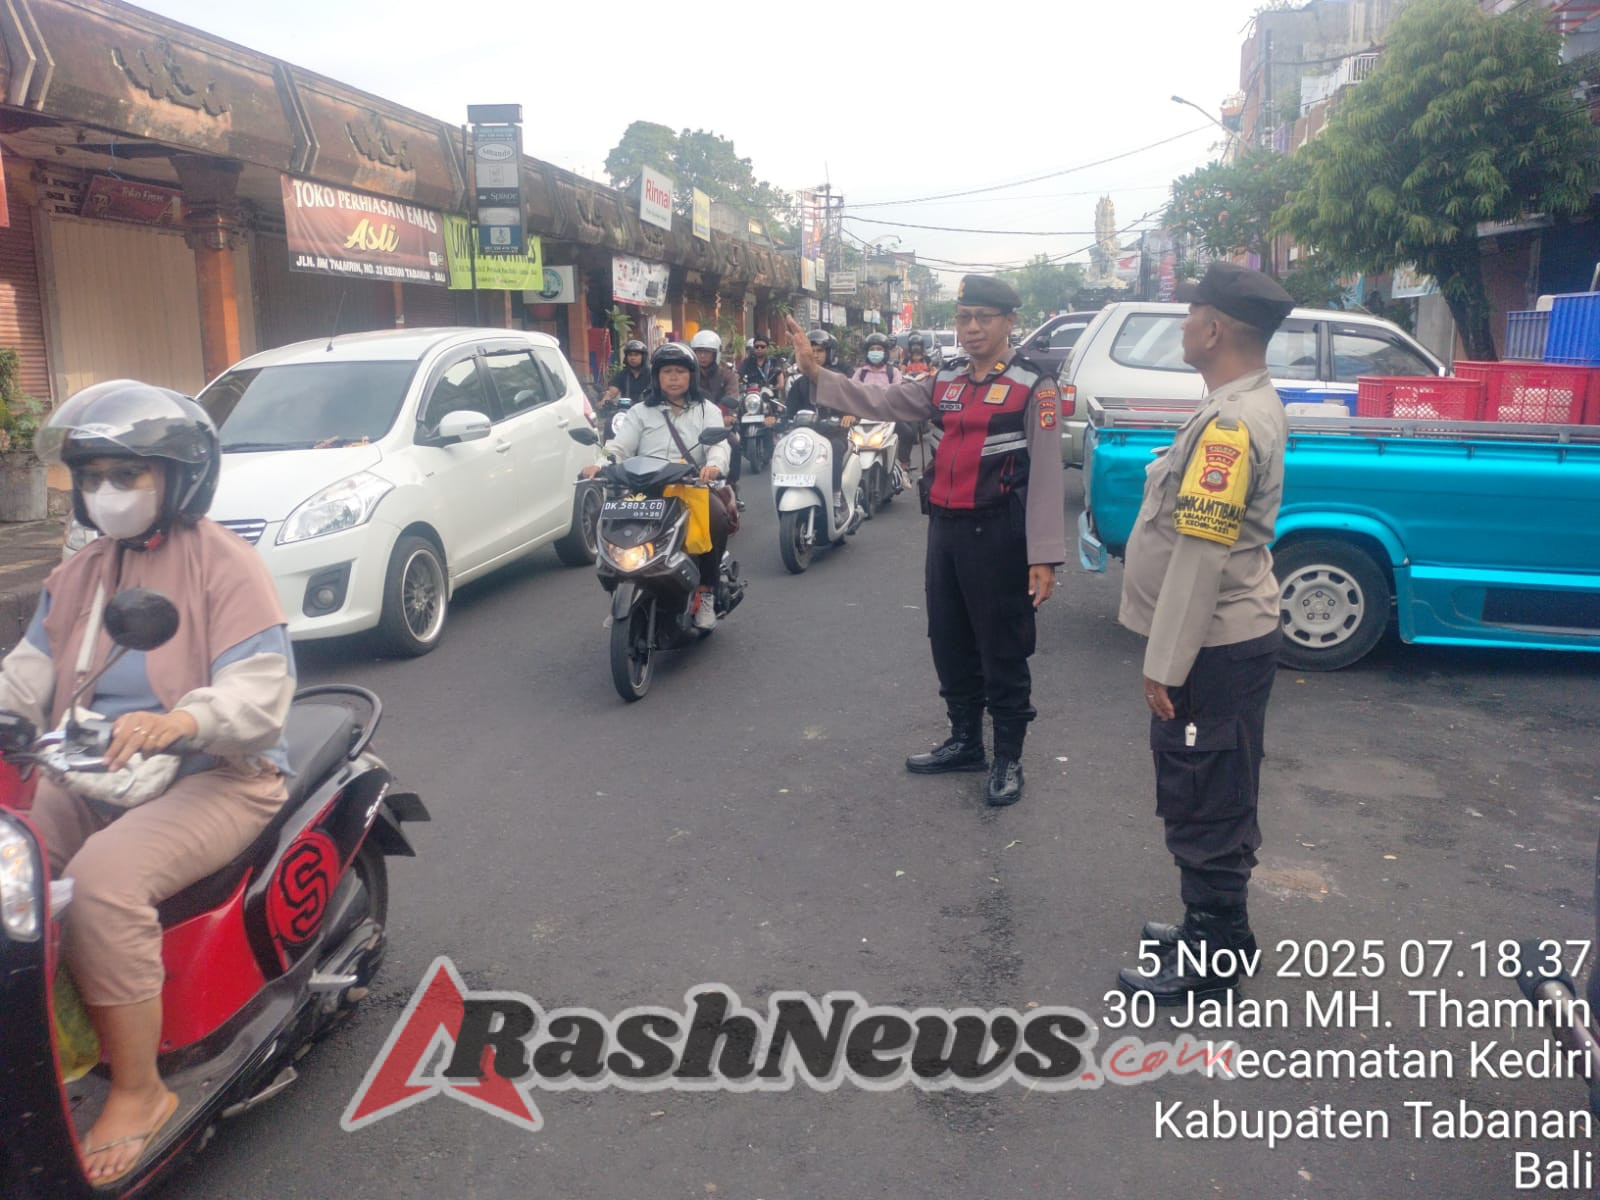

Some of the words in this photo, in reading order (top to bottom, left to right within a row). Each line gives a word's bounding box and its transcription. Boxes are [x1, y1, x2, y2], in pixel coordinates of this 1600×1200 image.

[292, 178, 336, 208] TOKO
[337, 189, 406, 221] PERHIASAN
[406, 204, 438, 234] EMAS
[344, 218, 400, 253] Asli
[604, 502, 618, 510] DK
